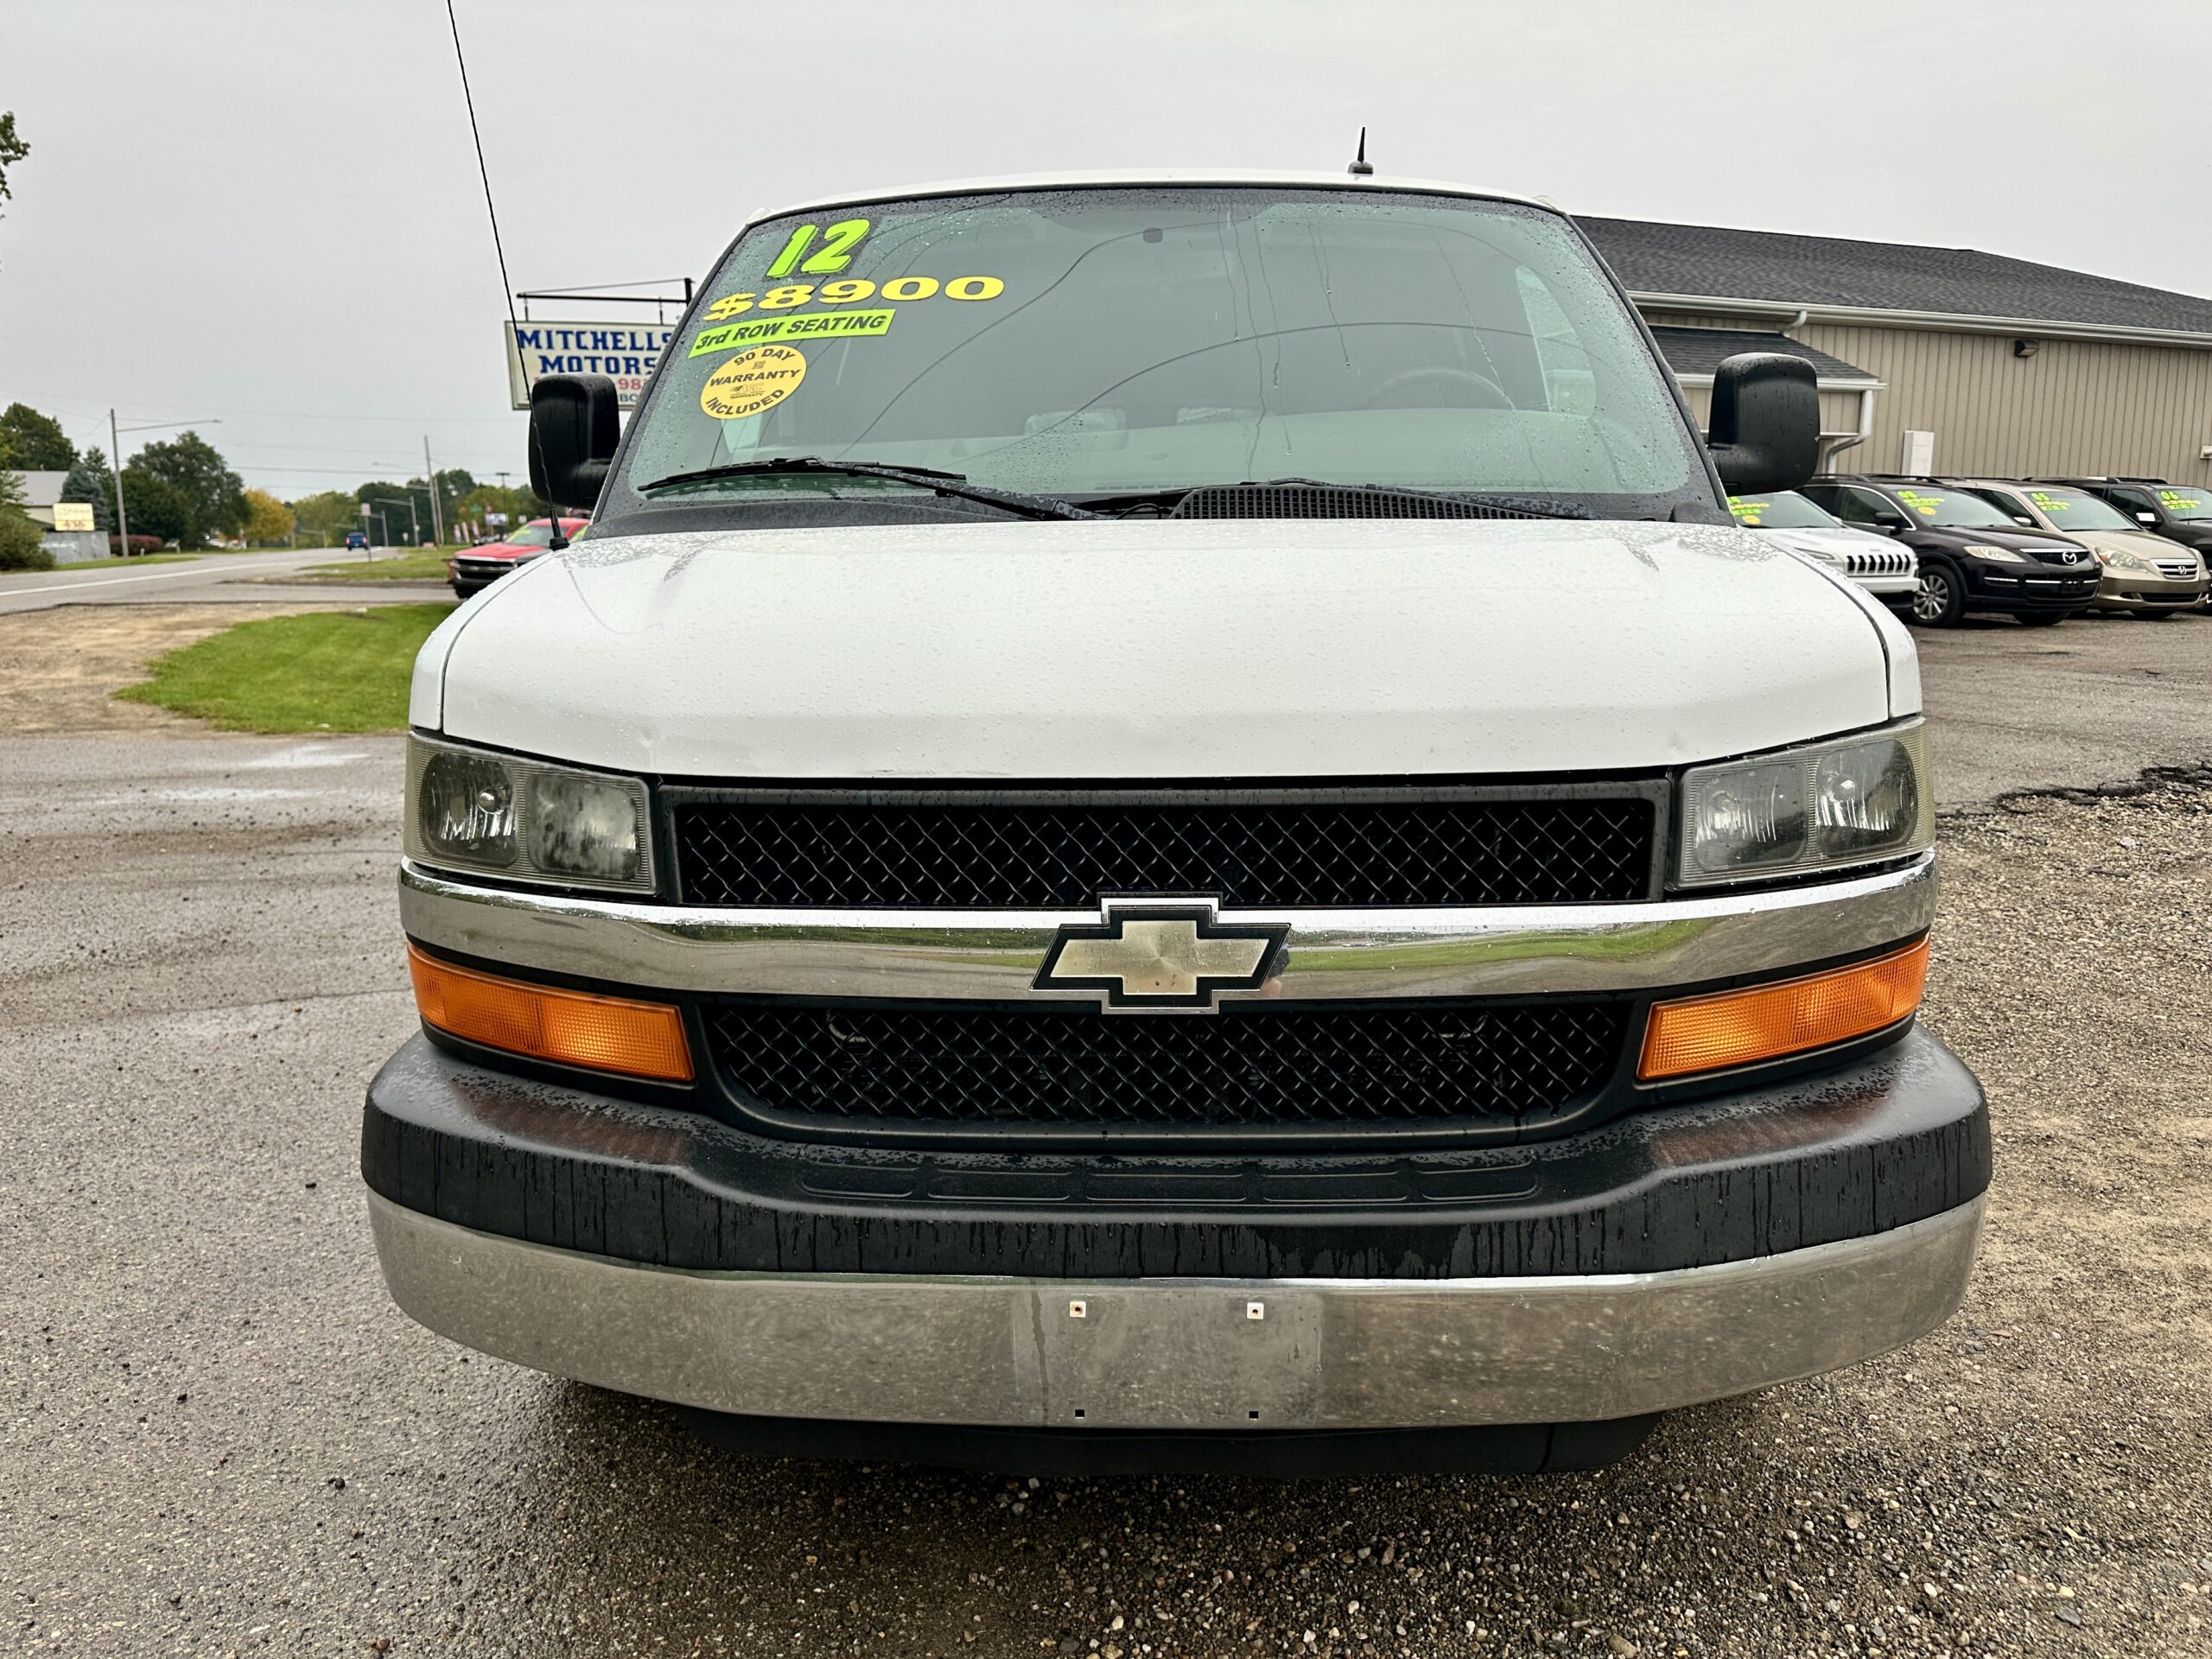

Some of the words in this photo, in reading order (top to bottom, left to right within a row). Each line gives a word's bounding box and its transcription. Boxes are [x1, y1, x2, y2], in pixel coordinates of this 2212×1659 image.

[766, 219, 870, 277] 12
[703, 276, 1004, 321] $8900
[696, 330, 731, 349] 3rd
[732, 321, 785, 342] ROW
[786, 315, 887, 335] SEATING
[538, 355, 658, 375] MOTORS
[734, 352, 756, 365] 90
[761, 348, 796, 360] DAY
[709, 369, 802, 386] WARRANTY
[706, 389, 785, 415] INCLUDED
